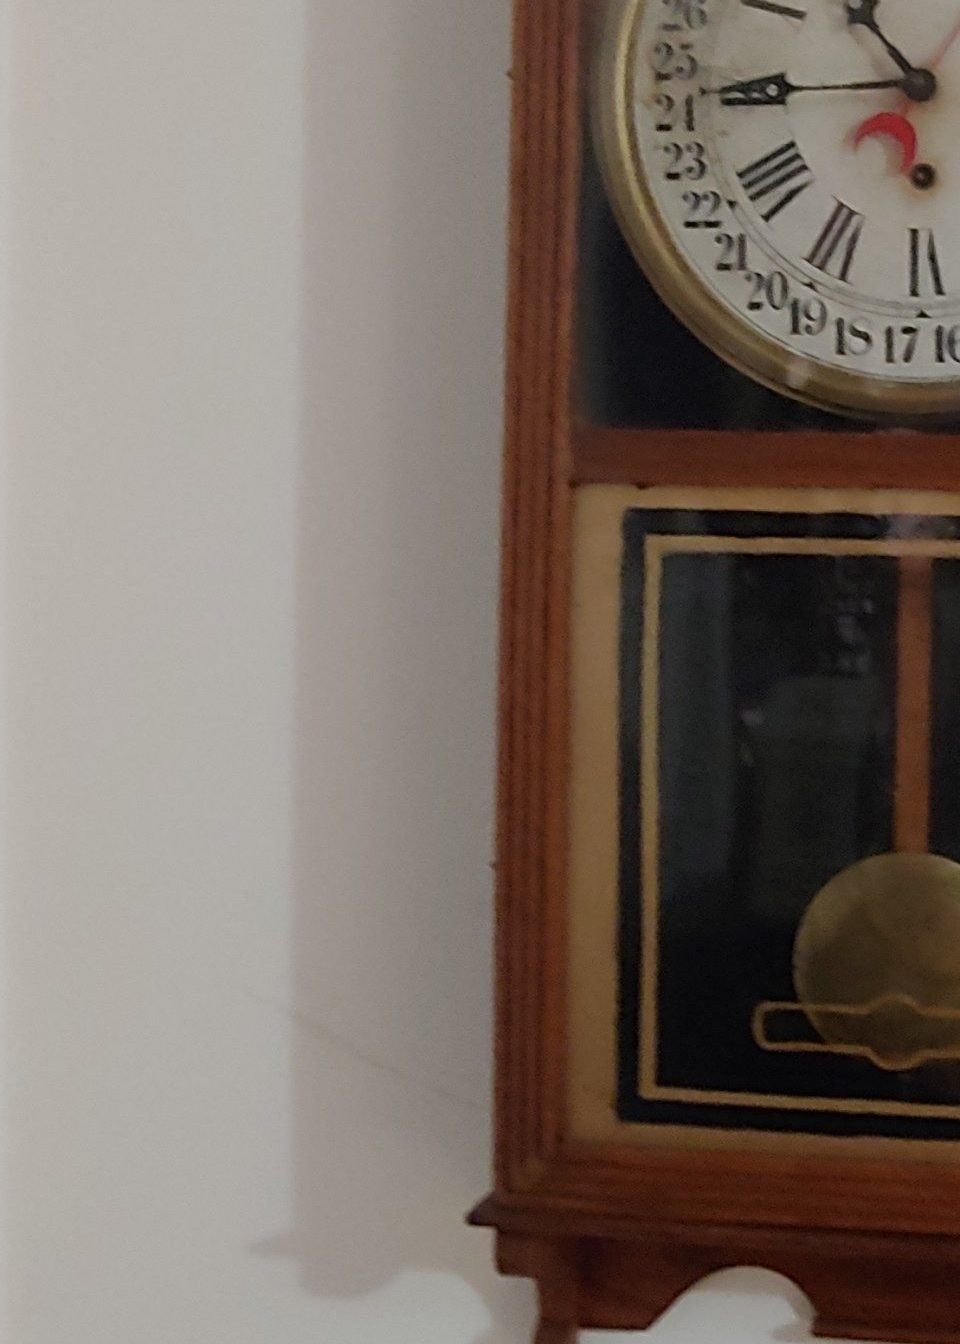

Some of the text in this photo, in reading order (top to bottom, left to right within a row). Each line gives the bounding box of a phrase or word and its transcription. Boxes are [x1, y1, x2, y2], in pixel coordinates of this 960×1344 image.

[654, 41, 698, 81] 25
[663, 142, 707, 180] 23
[682, 191, 722, 228] 22
[715, 233, 747, 271] 21
[745, 271, 789, 310] 20
[789, 297, 827, 335] 19
[835, 317, 873, 355] 18
[885, 326, 918, 363] 17
